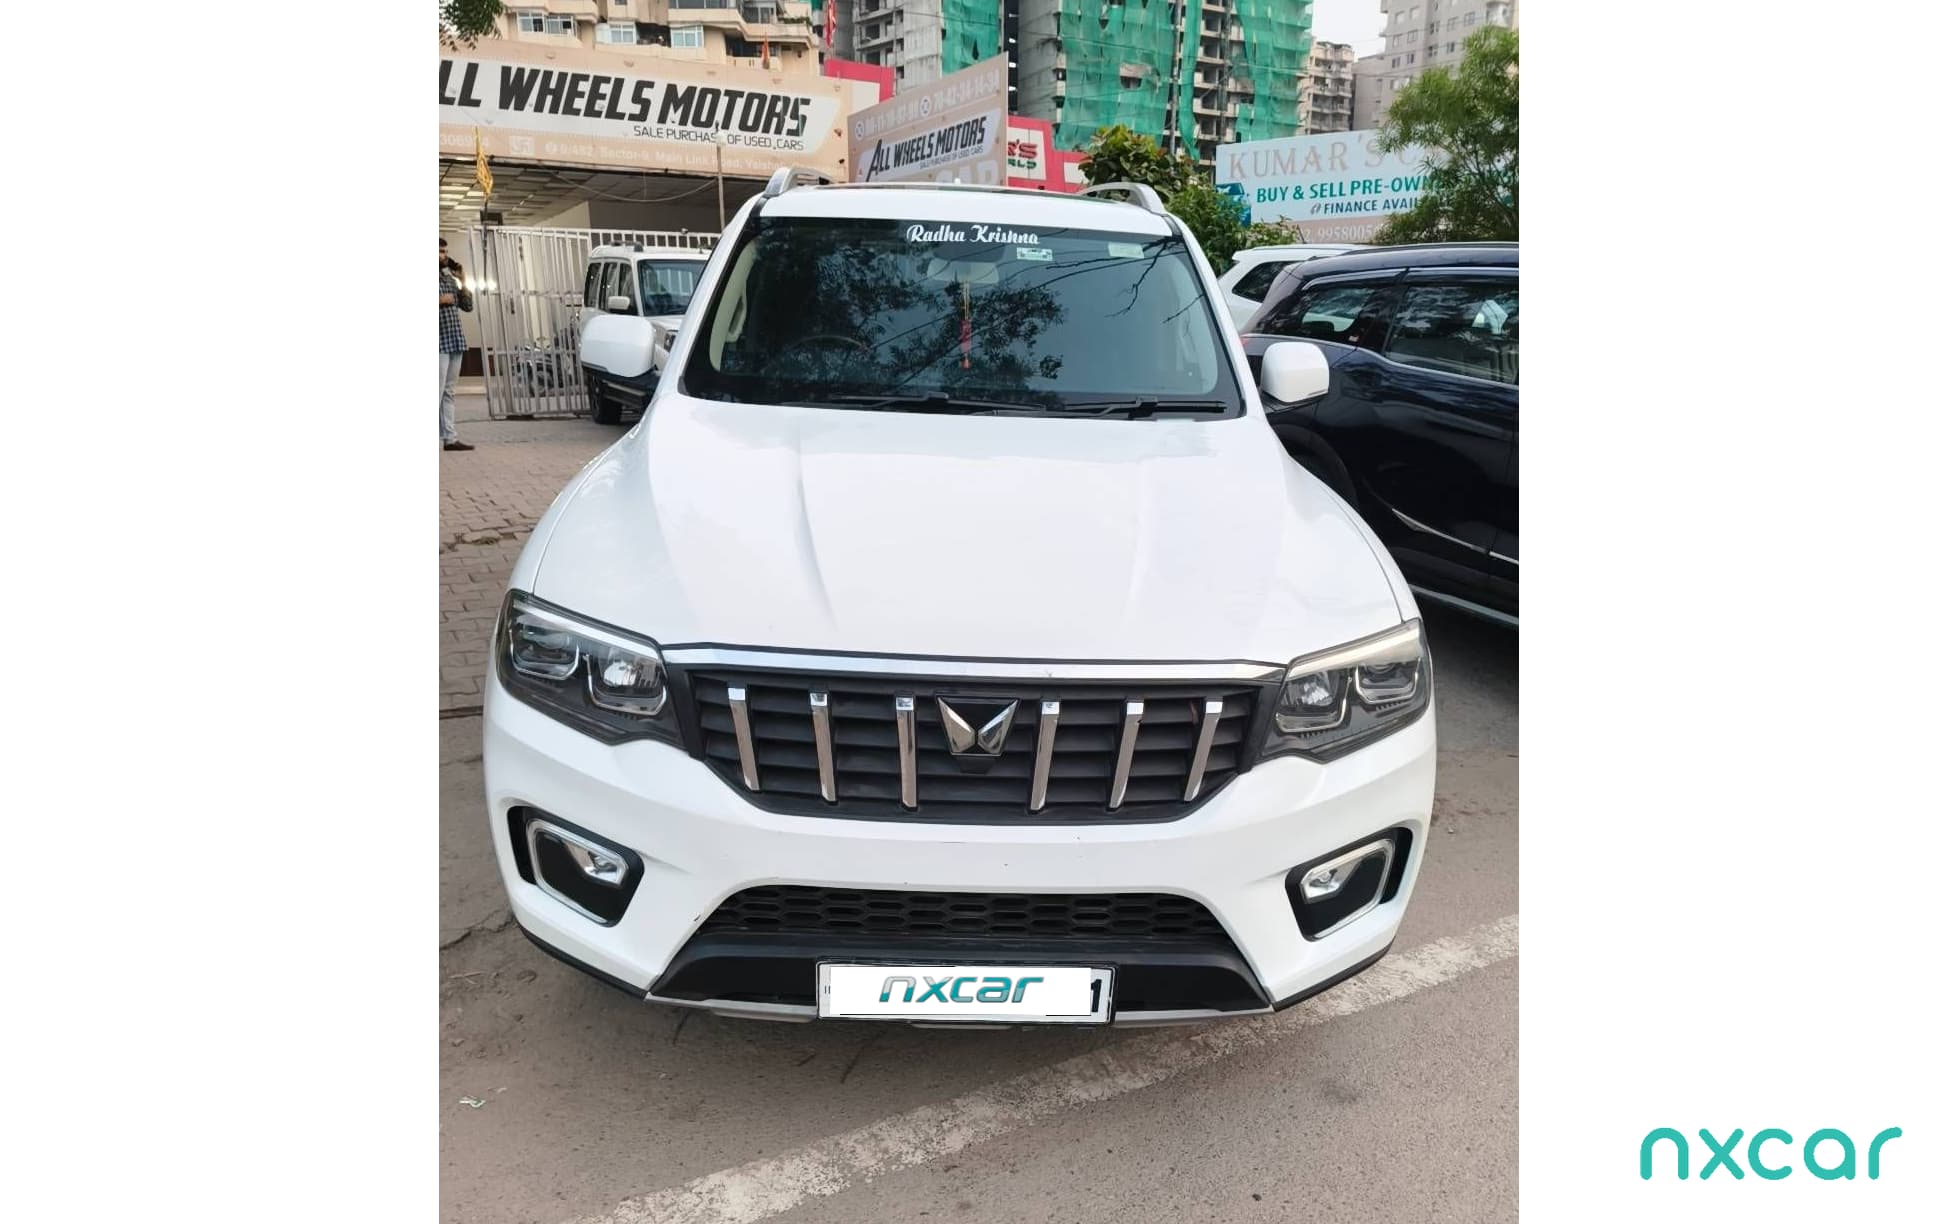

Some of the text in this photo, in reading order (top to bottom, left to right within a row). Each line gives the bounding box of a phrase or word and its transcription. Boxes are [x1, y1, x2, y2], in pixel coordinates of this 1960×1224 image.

[499, 65, 656, 123] WHEELS
[657, 83, 811, 137] MOTORS
[440, 133, 489, 147] 30694
[633, 125, 804, 151] SALE PURCHAS OF USED CARS
[866, 138, 890, 182] ALL
[893, 131, 935, 168] WHEELS
[935, 116, 987, 156] MOTORS
[1229, 135, 1386, 179] KUMAR'S
[1257, 186, 1289, 203] BUY
[1292, 185, 1304, 200] &
[1309, 182, 1346, 199] SELL
[1323, 200, 1378, 214] FINANCE
[906, 224, 1040, 245] Radha Krishna
